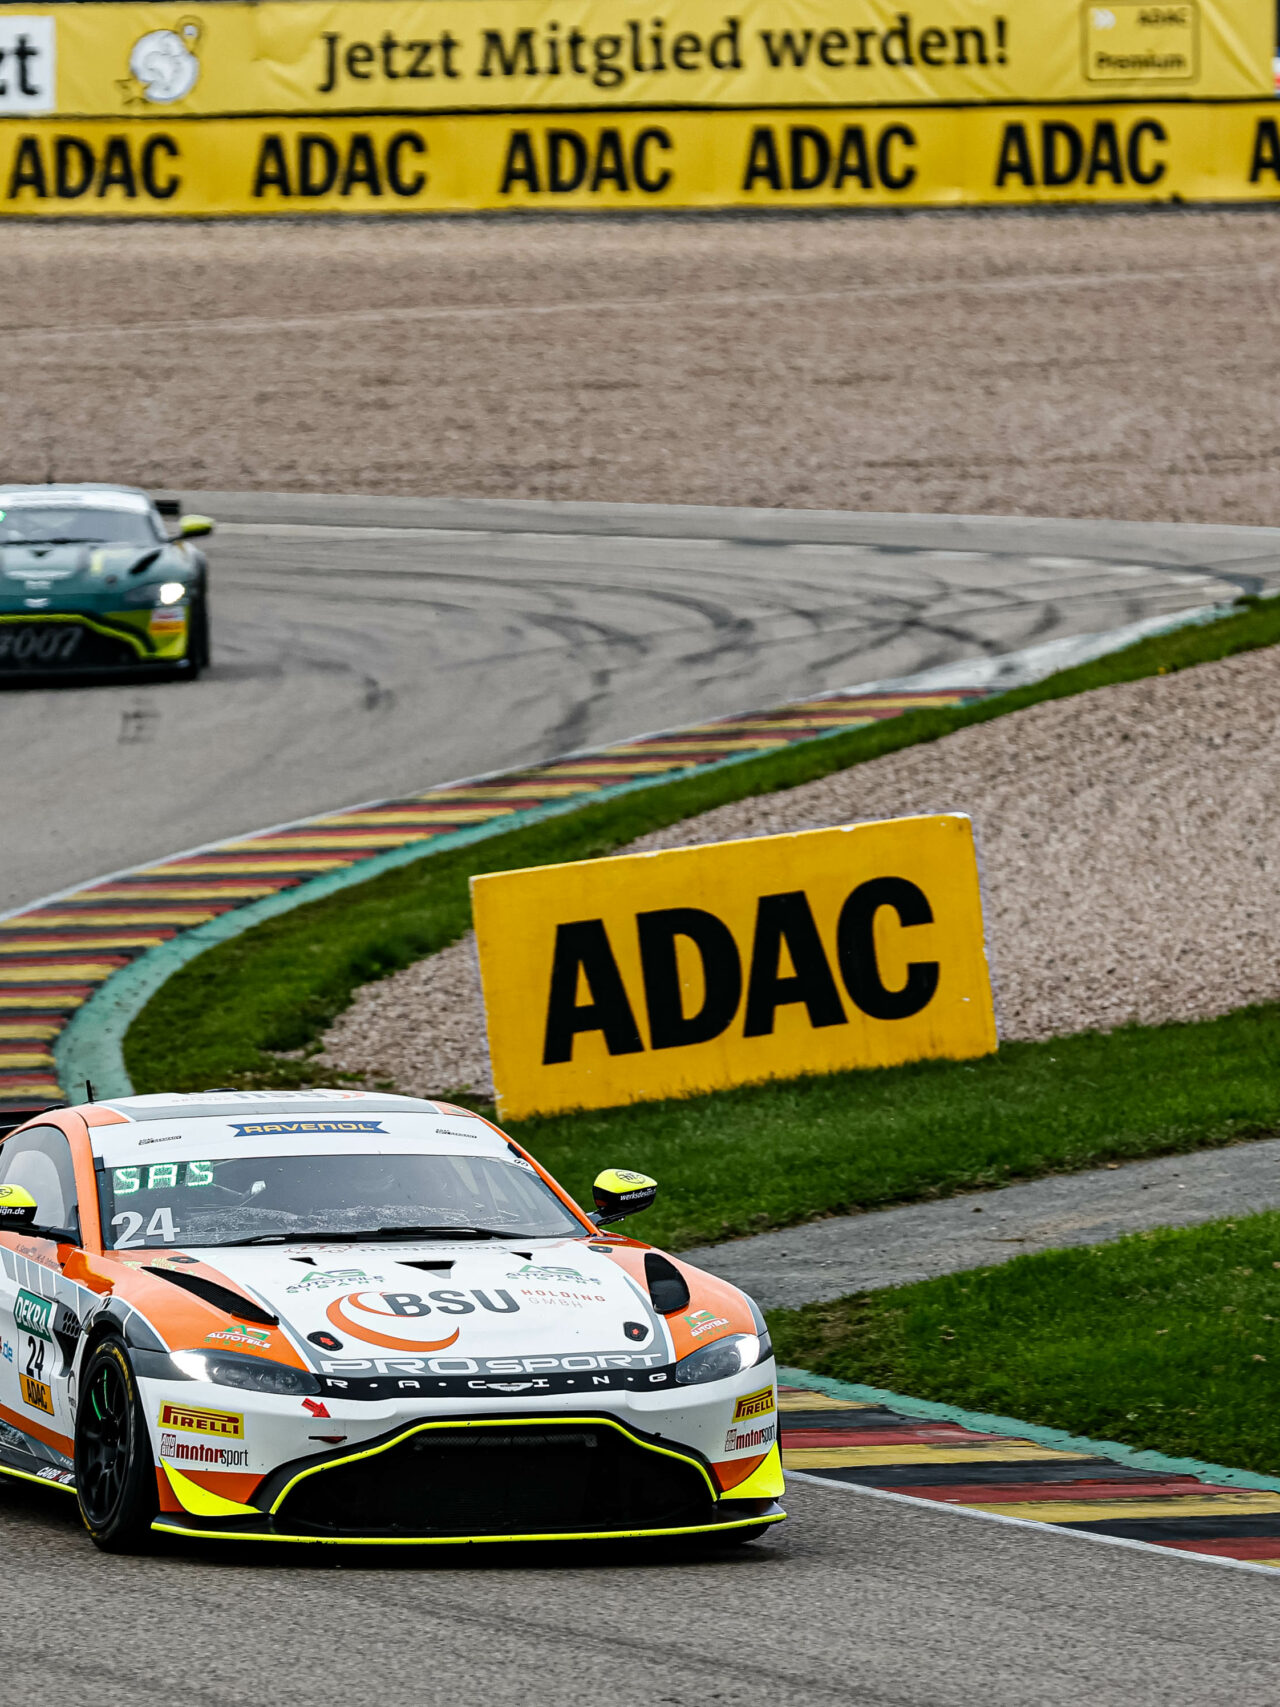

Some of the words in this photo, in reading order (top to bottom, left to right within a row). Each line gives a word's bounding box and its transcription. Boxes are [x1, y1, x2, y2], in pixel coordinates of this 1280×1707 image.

[317, 31, 460, 94] Jetzt
[476, 19, 743, 88] Mitglied
[759, 17, 1008, 70] werden!
[8, 132, 183, 200] ADAC
[250, 129, 427, 197] ADAC
[499, 125, 673, 194] ADAC
[741, 122, 919, 192] ADAC
[993, 117, 1167, 187] ADAC
[543, 876, 940, 1066] ADAC
[243, 1121, 373, 1134] RAVENOL
[113, 1160, 215, 1196] SAS
[110, 1207, 181, 1250] 24
[380, 1289, 521, 1317] BSU
[520, 1289, 606, 1302] HOLDING
[528, 1296, 584, 1309] GMBH
[14, 1296, 50, 1337] DEKRA
[25, 1335, 45, 1380] 24
[206, 1332, 272, 1349] AUTOTEILE
[26, 1378, 48, 1410] ADAC
[735, 1389, 774, 1418] PIRELLI
[162, 1405, 240, 1435] PIRELLI
[735, 1423, 776, 1450] motorsport
[176, 1443, 249, 1467] motorsport
